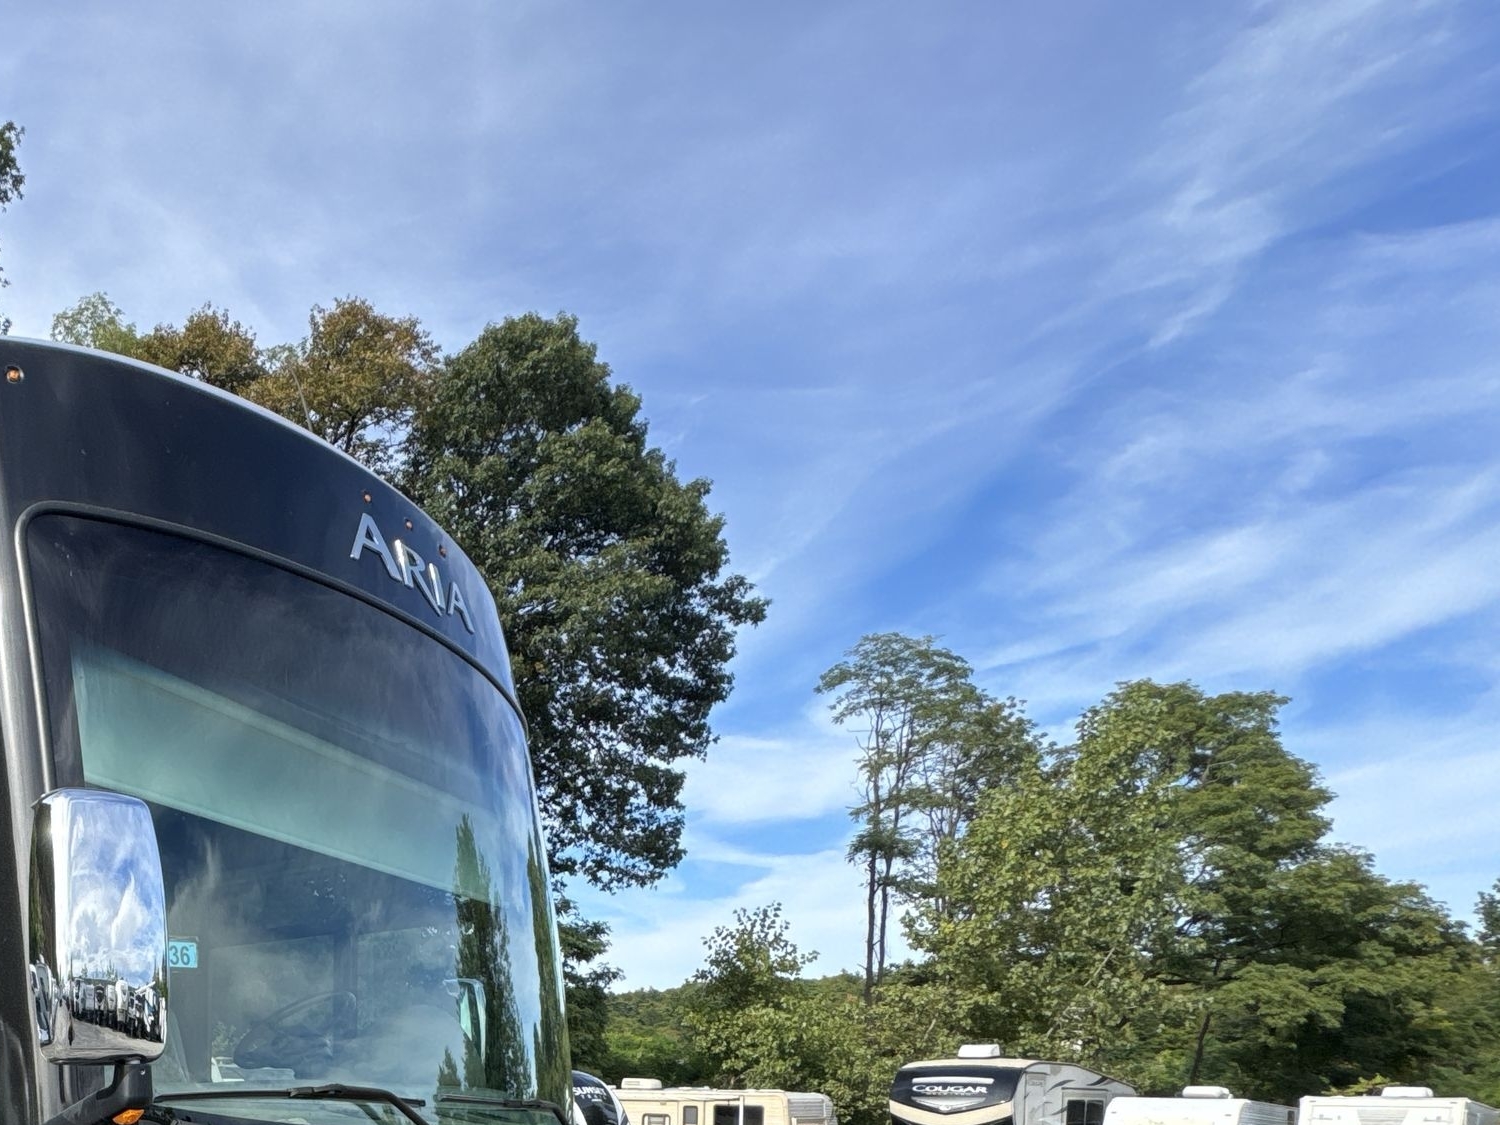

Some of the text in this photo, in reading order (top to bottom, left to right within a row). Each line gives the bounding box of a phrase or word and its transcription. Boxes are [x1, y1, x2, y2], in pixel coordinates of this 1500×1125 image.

[350, 512, 475, 635] ARIA
[169, 945, 191, 966] 36
[572, 1086, 606, 1095] SUNSET
[911, 1084, 988, 1094] COUGAR
